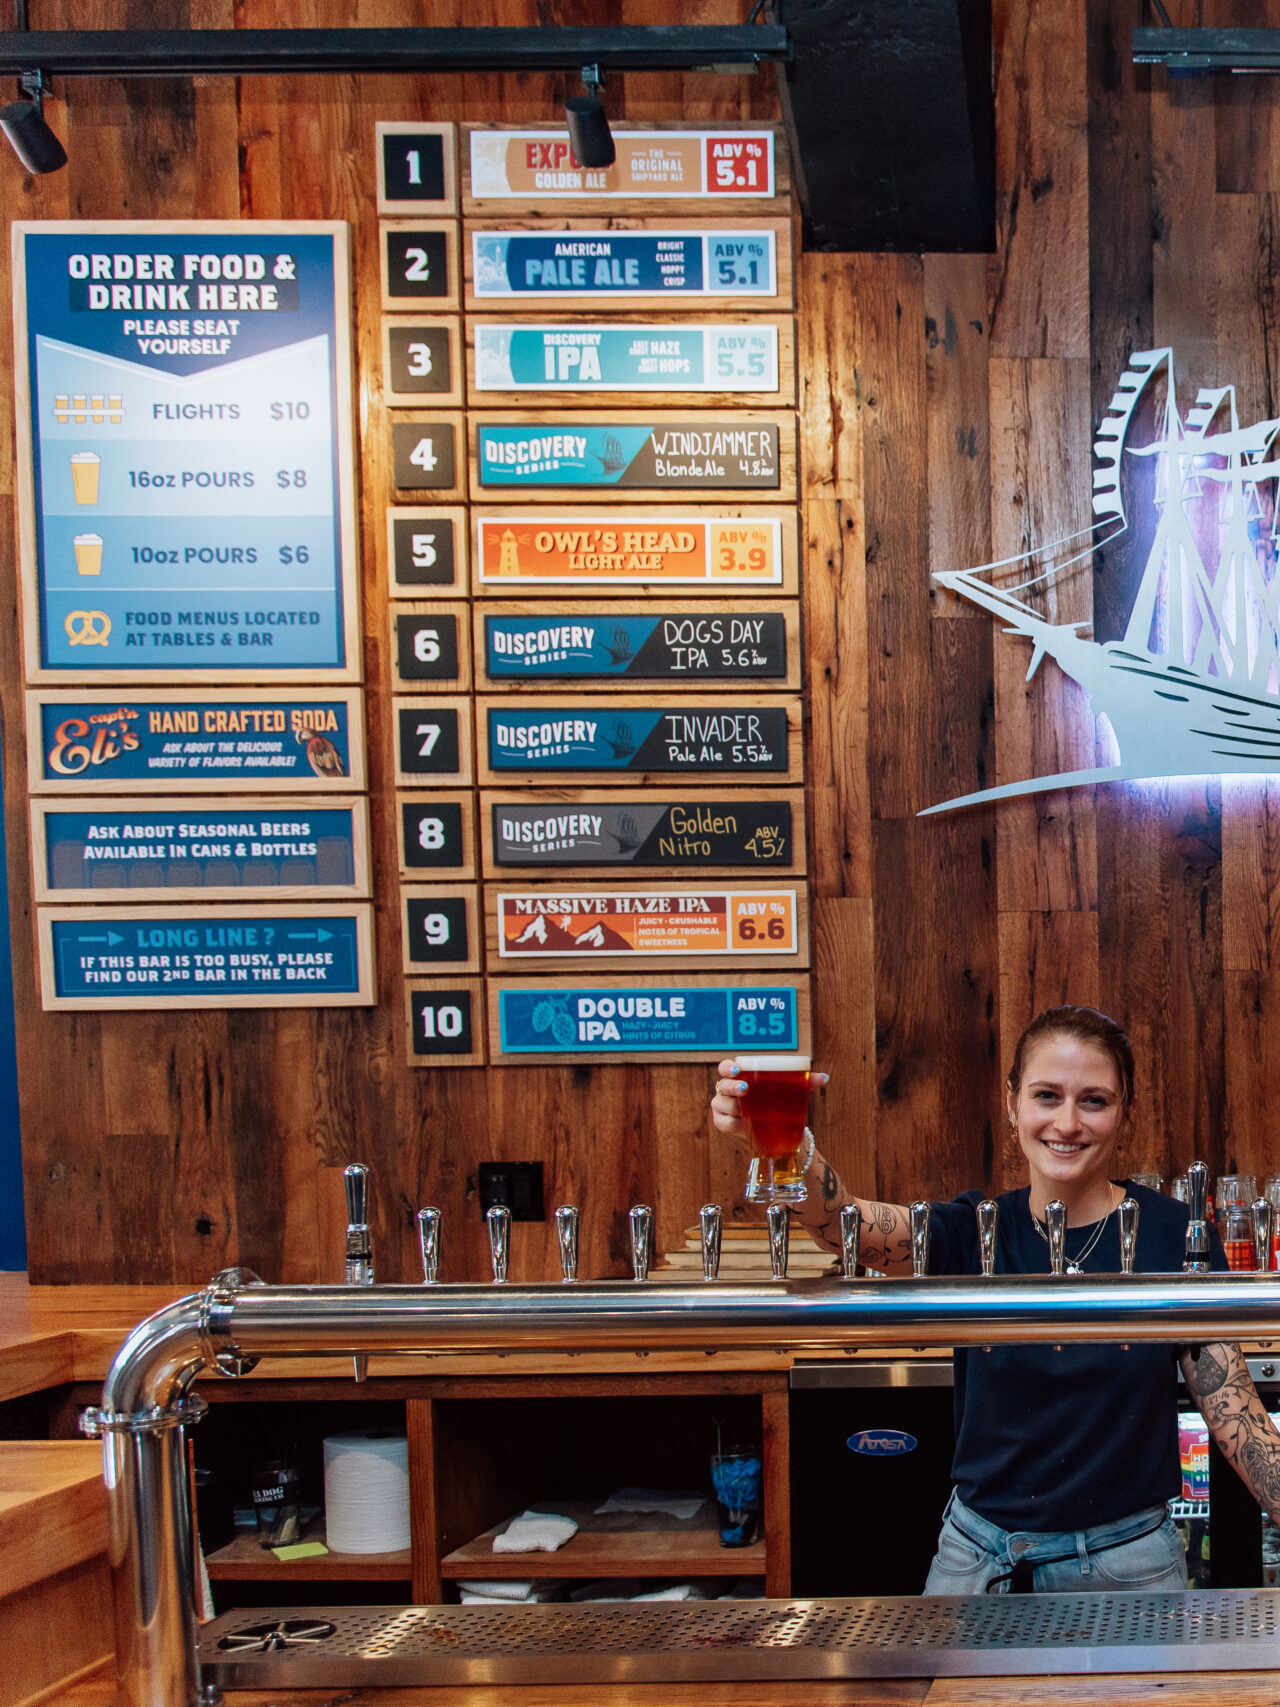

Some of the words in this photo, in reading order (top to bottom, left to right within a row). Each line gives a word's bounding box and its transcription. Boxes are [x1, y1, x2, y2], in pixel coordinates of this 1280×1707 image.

[526, 143, 610, 168] EXP
[631, 159, 683, 171] ORIGINAL
[649, 149, 663, 158] THE
[406, 151, 422, 184] 1
[716, 160, 757, 186] 5.1
[535, 173, 582, 189] GOLDEN
[586, 172, 607, 188] ALE
[555, 243, 611, 256] AMERICAN
[69, 254, 174, 280] ORDER
[184, 254, 266, 280] FOOD
[273, 254, 296, 280] &
[404, 248, 430, 281] 2
[525, 259, 587, 286] PALE
[594, 259, 639, 285] ALE
[719, 261, 758, 285] 5.1
[89, 284, 191, 310] DRINK
[198, 284, 279, 310] HERE
[123, 320, 190, 336] PLEASE
[193, 319, 240, 336] SEAT
[138, 338, 231, 355] YOURSELF
[543, 334, 602, 345] DISCOVERY
[651, 341, 681, 356] HAZE
[408, 343, 433, 376] 3
[545, 347, 602, 381] IPA
[660, 359, 690, 374] HOPS
[717, 353, 765, 376] 5.5
[152, 403, 241, 420] FLIGHTS
[270, 401, 310, 421] $10
[409, 438, 437, 471] 4
[652, 431, 772, 457] WINDJAMMER
[129, 470, 176, 488] 16oz
[182, 471, 255, 489] POURS
[277, 470, 307, 489] $8
[412, 534, 437, 567] 5
[623, 531, 696, 554] HEAD
[131, 546, 179, 564] 10oz
[184, 547, 257, 565] POURS
[280, 545, 309, 566] $6
[569, 555, 625, 570] LIGHT
[628, 555, 664, 570] ALE
[719, 548, 767, 571] 3.9
[125, 612, 173, 626] FOOD
[178, 612, 239, 626] MENUS
[245, 612, 320, 626] LOCATED
[125, 632, 145, 646] AT
[151, 632, 216, 646] TABLES
[221, 632, 233, 646] &
[238, 632, 273, 646] BAR
[664, 619, 723, 645] DOGS
[730, 620, 765, 644] DAY
[413, 630, 440, 663] 6
[670, 647, 709, 670] IPA
[150, 711, 199, 733] HAND
[204, 710, 285, 733] CRAFTED
[291, 709, 339, 733] SODA
[665, 715, 762, 743] INVADER
[163, 742, 181, 752] ASK
[184, 742, 215, 752] ABOUT
[218, 742, 235, 752] THE
[237, 742, 282, 752] DELICIOUS
[416, 724, 442, 756] 7
[148, 757, 187, 767] VARIETY
[189, 757, 200, 767] OF
[202, 756, 242, 767] FLAVORS
[244, 756, 296, 767] AVAILABLE!
[669, 746, 696, 763] Pale
[700, 746, 723, 763] Ale
[670, 807, 738, 835] Golden
[419, 818, 445, 850] 8
[660, 837, 711, 857] Nitro
[515, 899, 609, 915] MASSIVE
[616, 898, 672, 914] HAZE
[679, 897, 711, 913] IPA
[424, 913, 450, 945] 9
[639, 928, 665, 936] NOTES
[739, 918, 785, 941] 6.6
[578, 997, 686, 1019] DOUBLE
[422, 1006, 462, 1038] 10
[578, 1021, 621, 1042] IPA
[739, 1013, 785, 1036] 8.5
